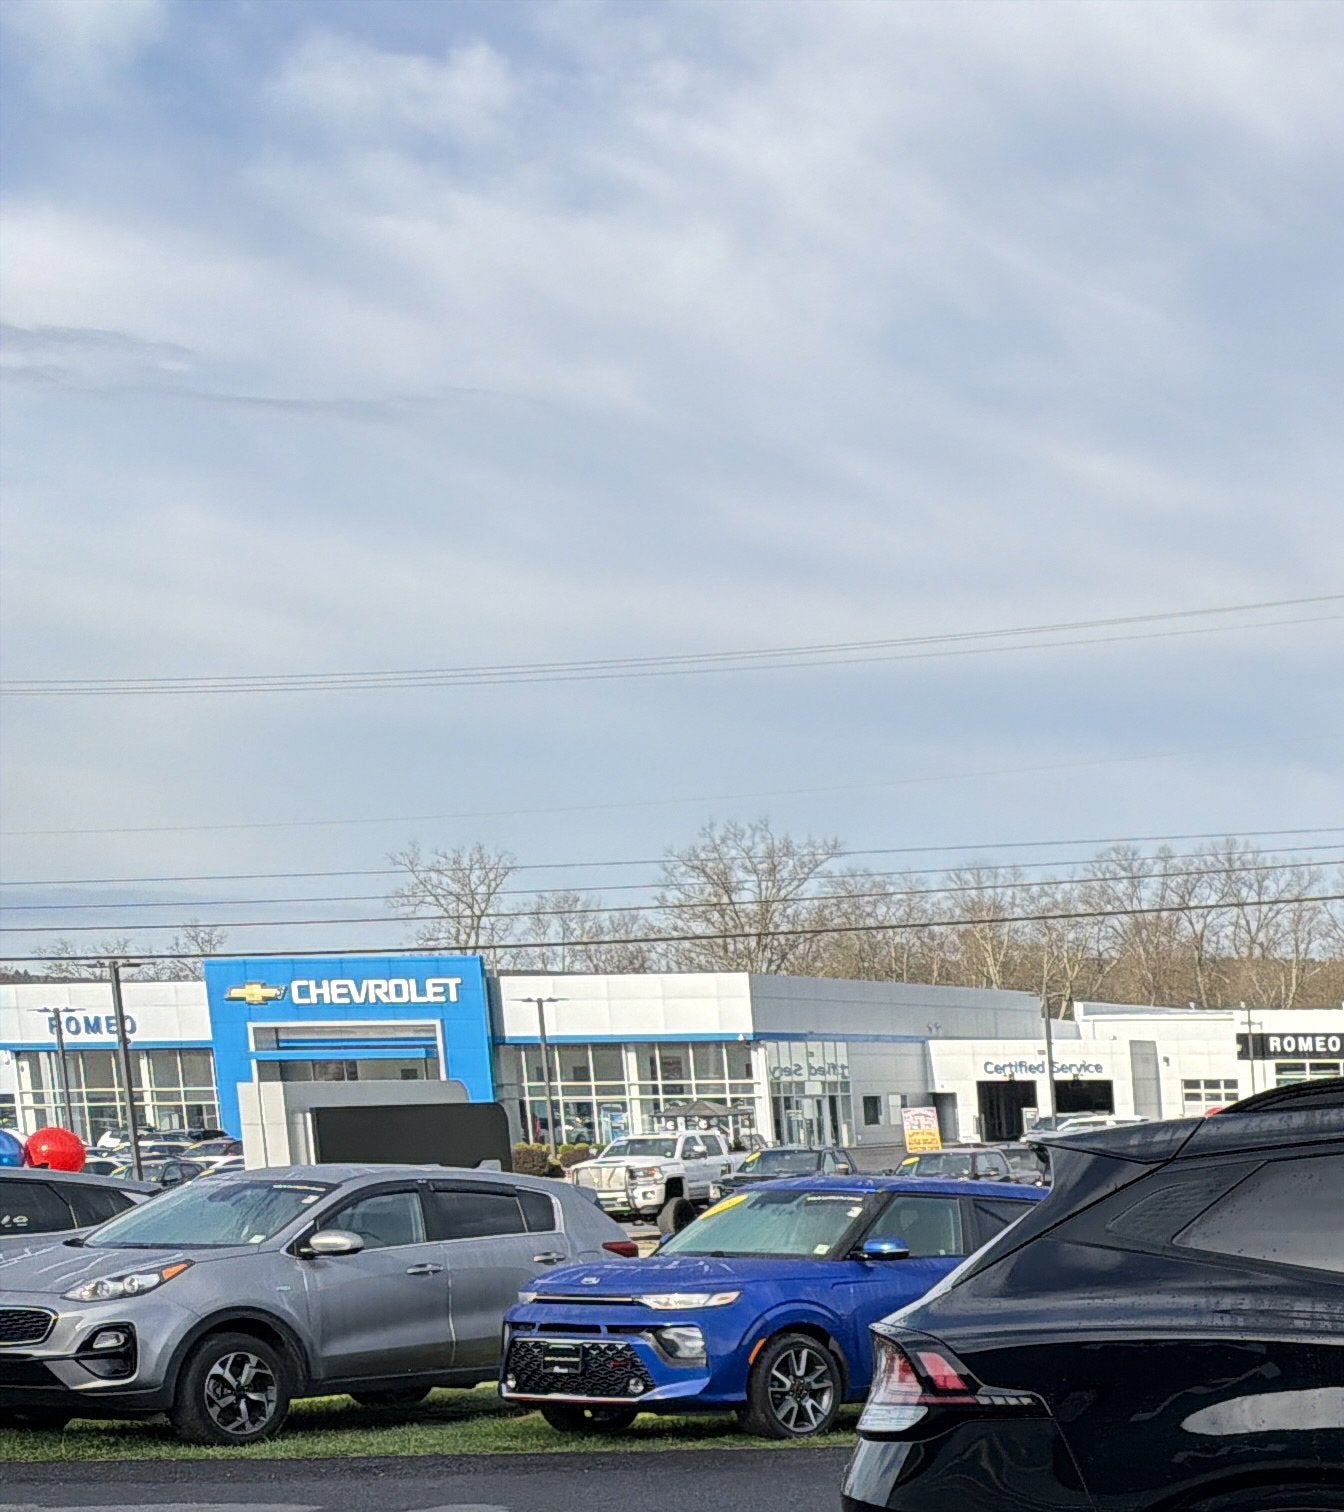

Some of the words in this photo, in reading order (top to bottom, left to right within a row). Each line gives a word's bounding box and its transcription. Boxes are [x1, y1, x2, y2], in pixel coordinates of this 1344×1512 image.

[290, 977, 462, 1005] CHEVROLET
[47, 1014, 138, 1036] ROMEO
[1268, 1034, 1342, 1053] ROMEO
[983, 1061, 1046, 1075] Certified
[1049, 1060, 1104, 1075] Service
